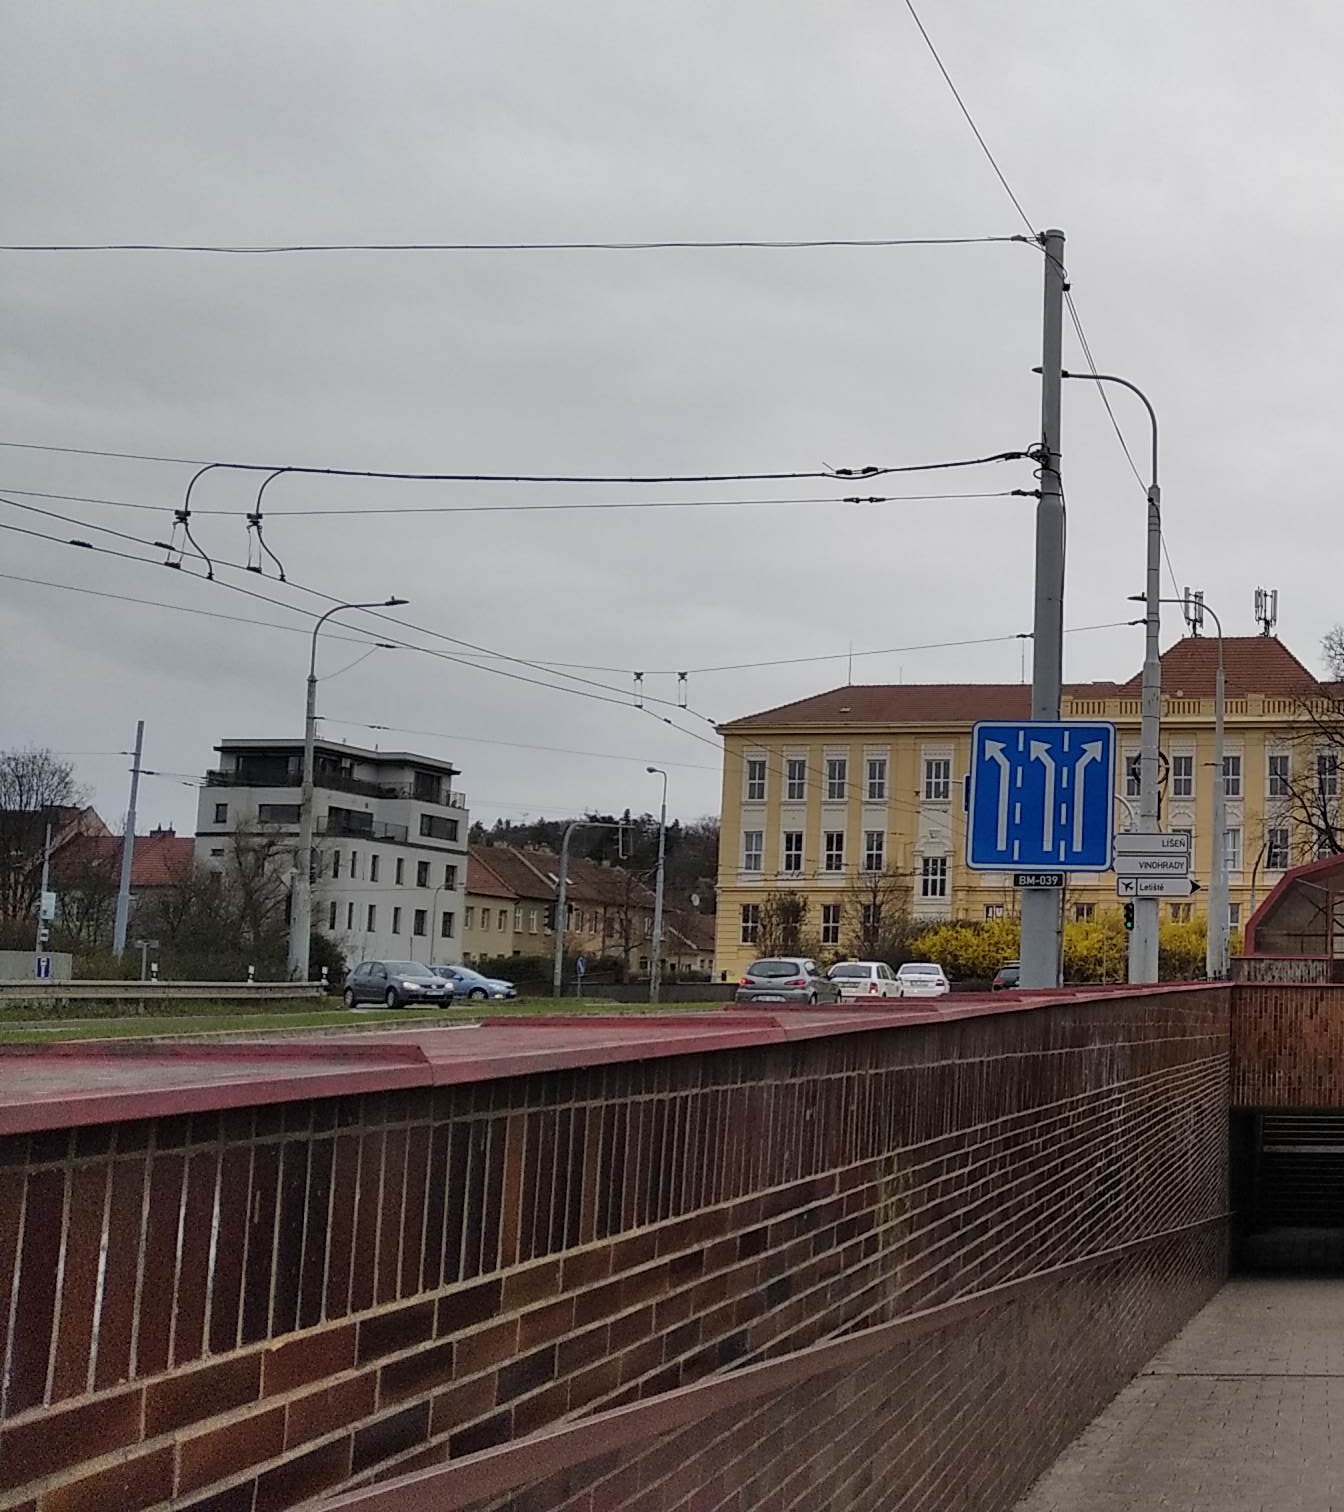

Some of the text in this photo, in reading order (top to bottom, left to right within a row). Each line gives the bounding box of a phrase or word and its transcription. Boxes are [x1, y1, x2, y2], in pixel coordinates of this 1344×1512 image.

[1161, 837, 1186, 848] LÍŠEŇ
[1138, 861, 1184, 870] VINOHRADY
[1018, 875, 1059, 886] BM-039
[1139, 882, 1165, 892] Letiště
